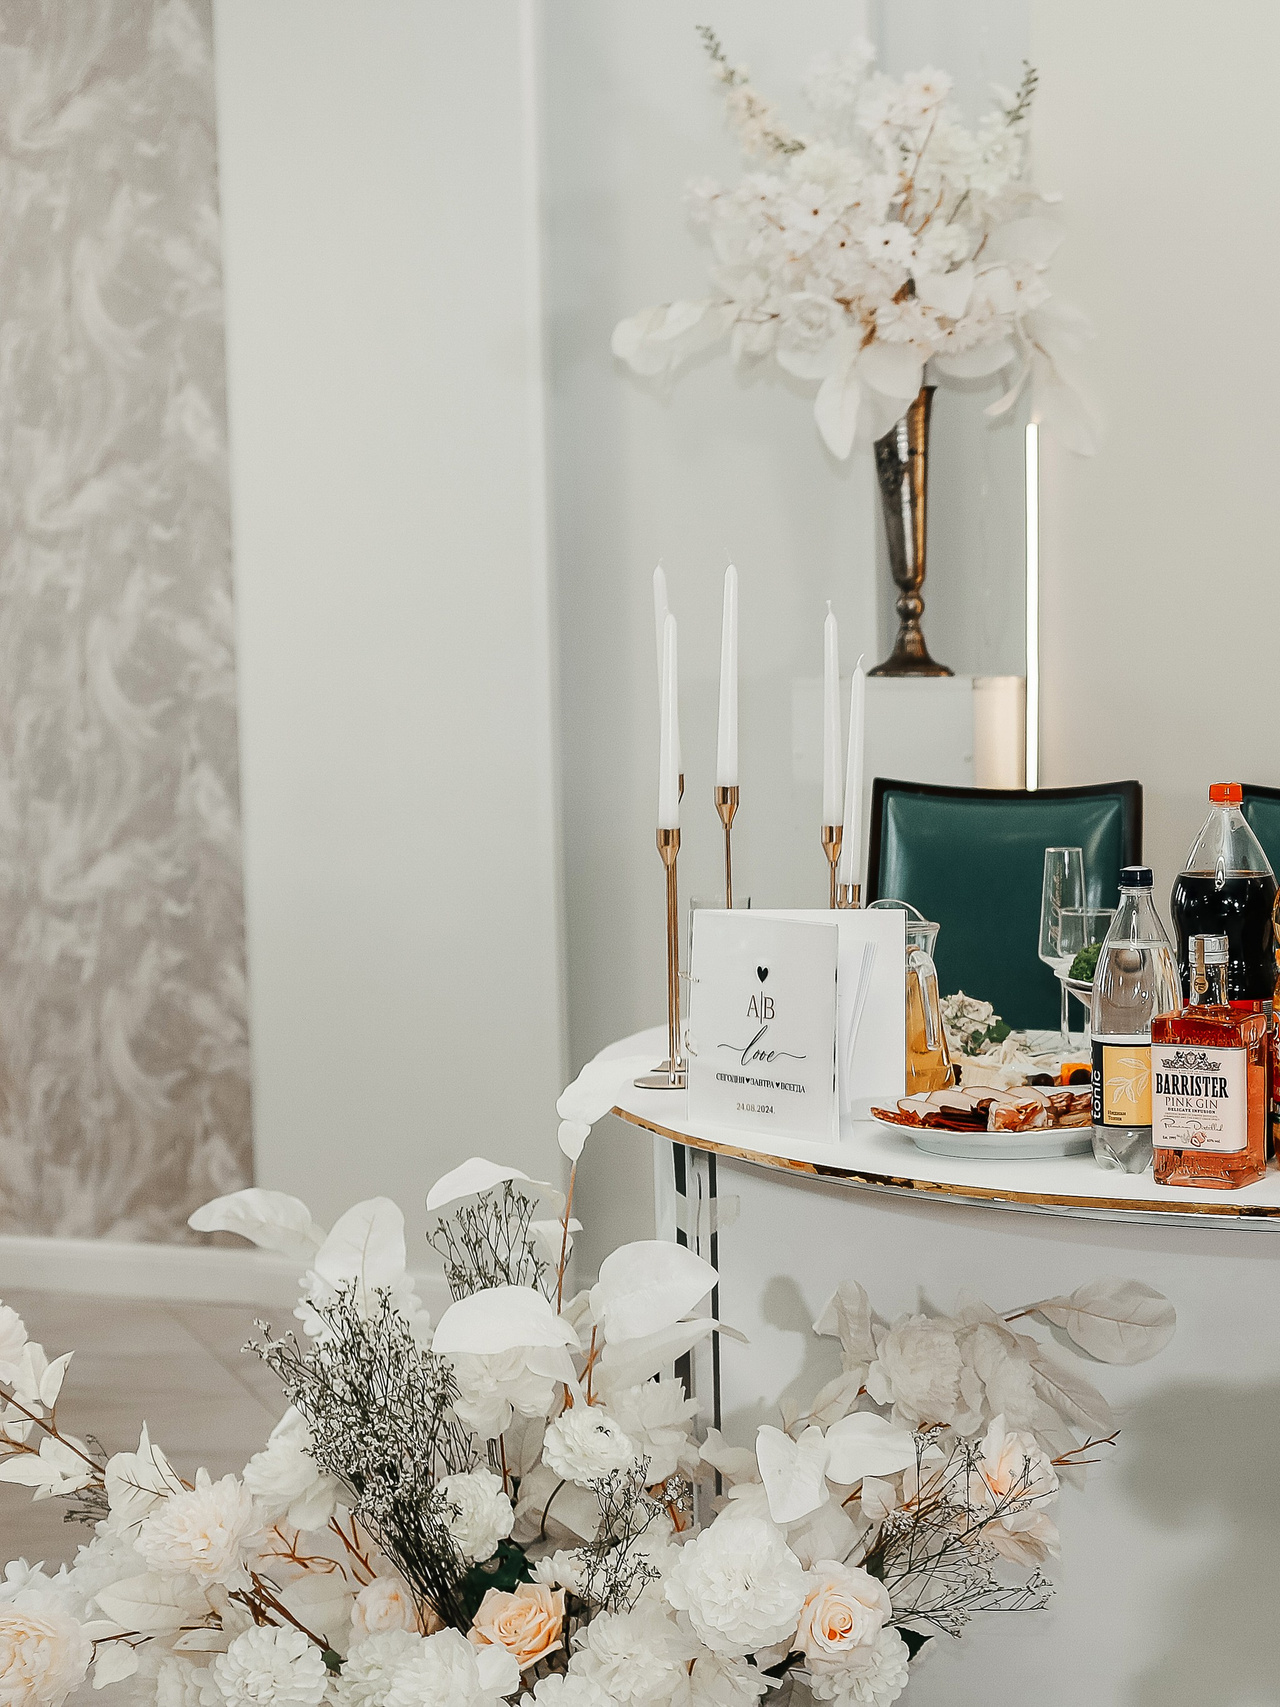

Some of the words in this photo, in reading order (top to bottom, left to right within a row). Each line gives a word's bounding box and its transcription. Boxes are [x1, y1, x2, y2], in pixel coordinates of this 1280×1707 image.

[717, 1025, 806, 1066] love
[751, 1078, 774, 1089] ЗАВТРА
[780, 1082, 805, 1093] ВСЕГДА
[1093, 1070, 1101, 1119] tonic
[1156, 1073, 1229, 1098] BARRISTER
[1165, 1096, 1193, 1108] PINK
[1195, 1098, 1218, 1109] GIN
